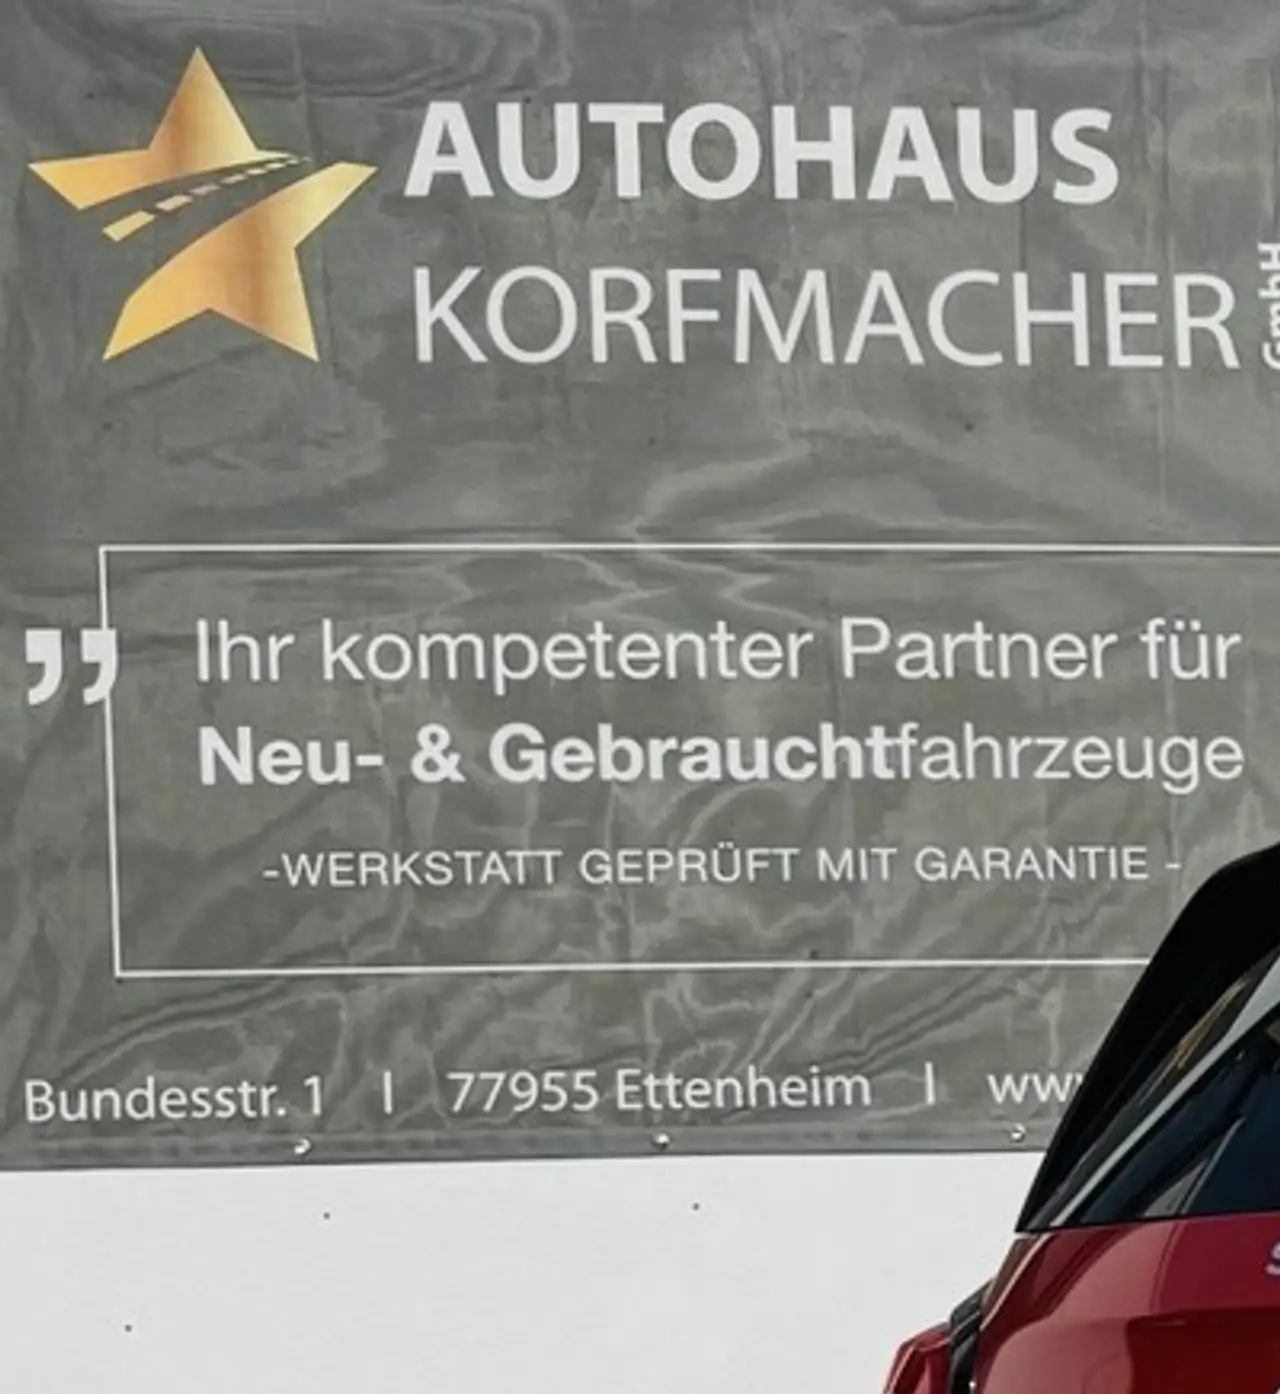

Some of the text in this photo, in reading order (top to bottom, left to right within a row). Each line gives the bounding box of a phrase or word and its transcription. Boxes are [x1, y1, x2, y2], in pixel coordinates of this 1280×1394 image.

[404, 100, 1120, 205] AUTOHAUS
[413, 264, 1241, 369] KORFMACHER
[196, 616, 1243, 697] Ihr kompetenter Partner für
[200, 719, 1246, 796] Neu- & Gebrauchtfahrzeuge
[578, 840, 799, 886] GEPRÜFT
[816, 846, 897, 882] MIT
[914, 845, 1149, 883] GARANTIE
[24, 1074, 288, 1123] Bundesstr.
[303, 1074, 324, 1116] 1
[447, 1069, 599, 1114] 77955
[615, 1063, 871, 1112] Ettenheim
